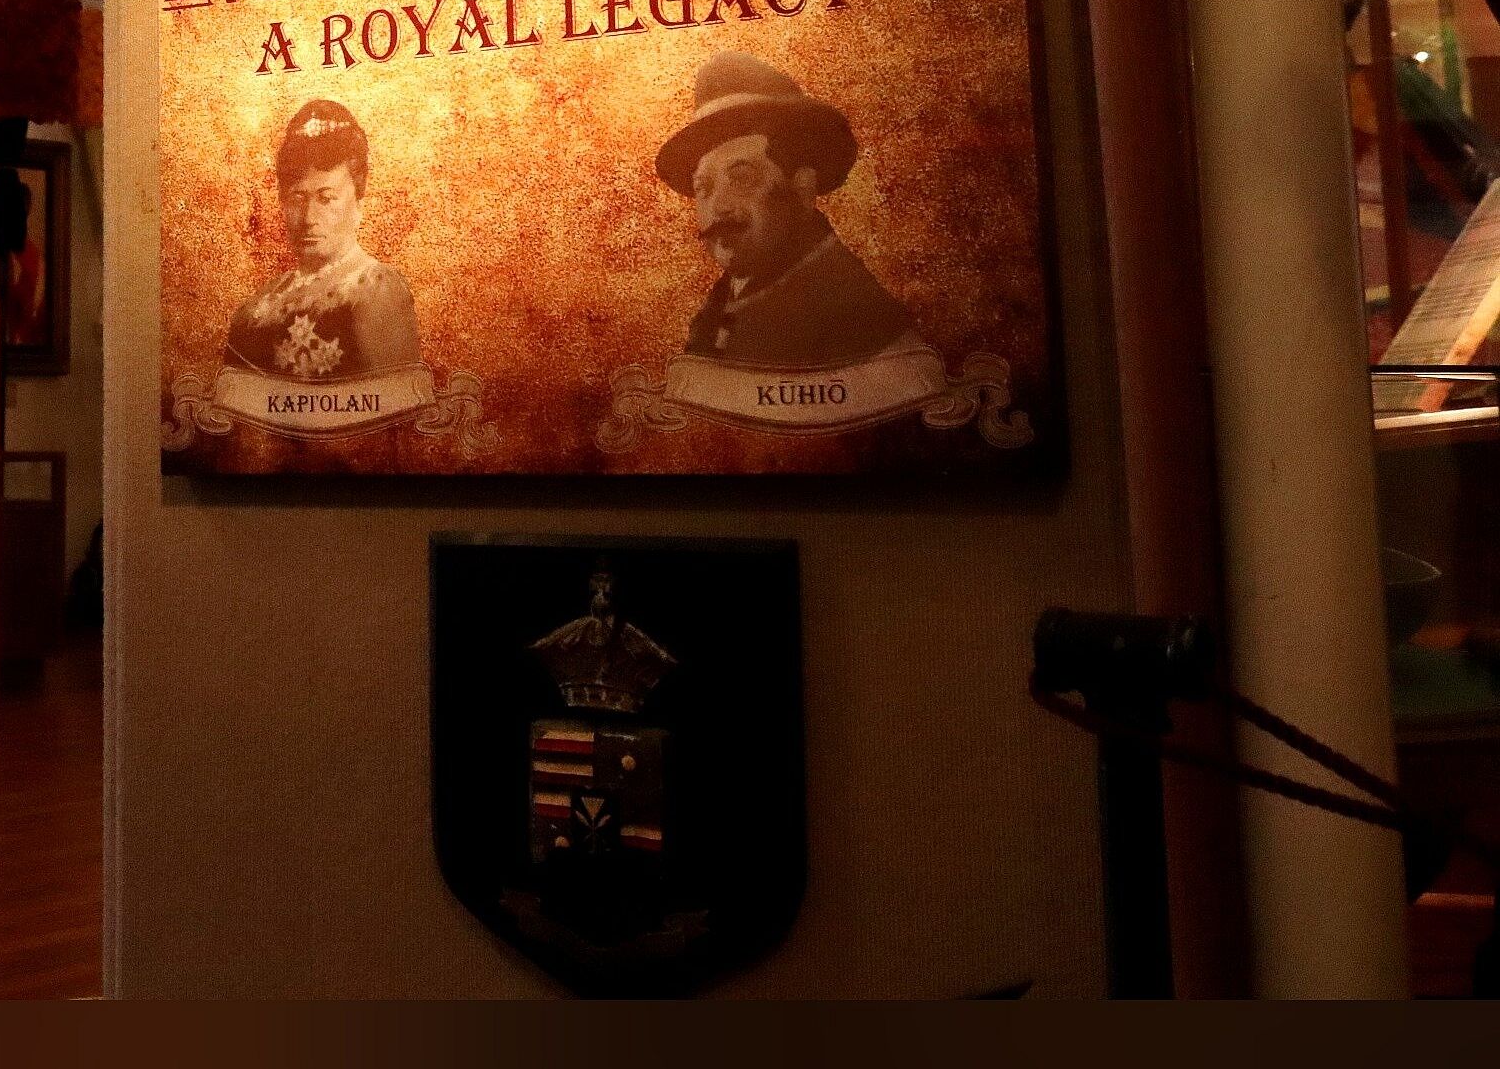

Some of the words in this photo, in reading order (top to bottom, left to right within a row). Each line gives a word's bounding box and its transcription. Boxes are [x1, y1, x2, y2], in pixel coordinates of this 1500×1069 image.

[254, 21, 301, 76] A
[267, 394, 380, 413] KAPI'OLANI
[756, 379, 846, 406] KŪHIŌ
